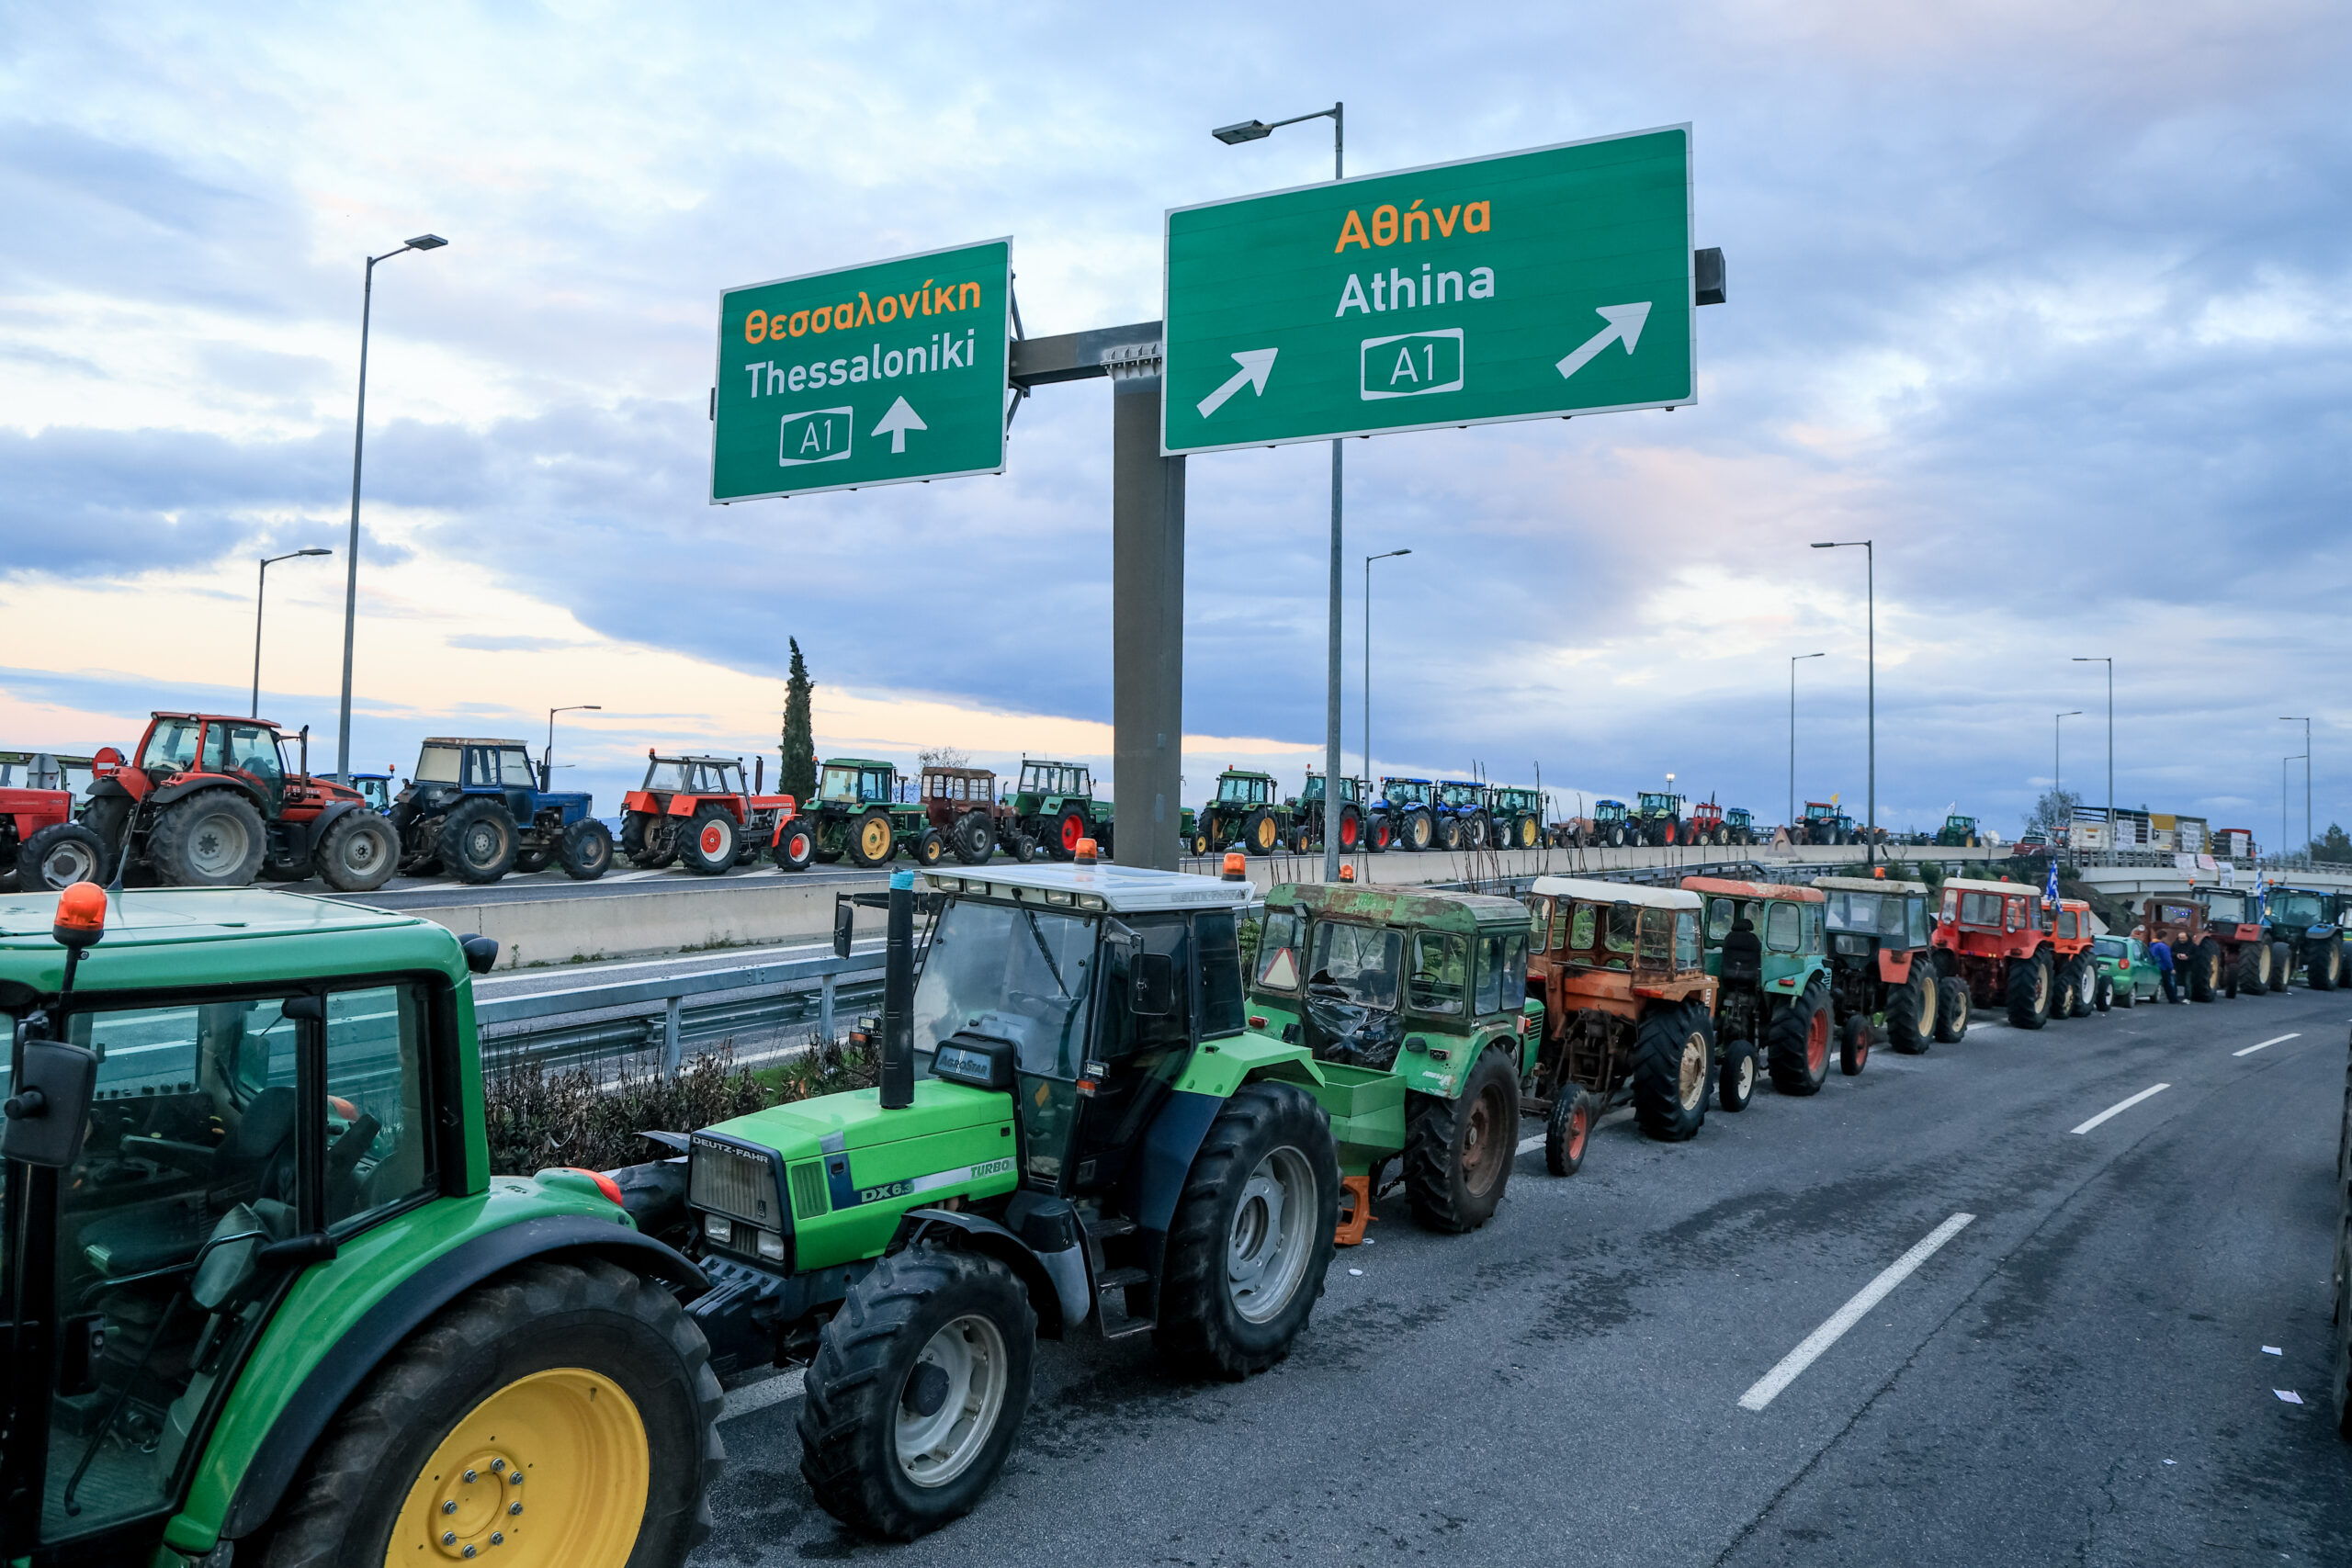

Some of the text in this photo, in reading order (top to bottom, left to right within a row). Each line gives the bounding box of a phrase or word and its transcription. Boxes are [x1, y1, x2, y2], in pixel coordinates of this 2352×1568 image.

[1334, 198, 1490, 254] Αθήνα
[745, 278, 980, 344] Θεσσαλονίκη
[1335, 263, 1495, 318] Athina
[744, 329, 975, 399] Thessaloniki
[1389, 344, 1435, 386] A1
[799, 419, 831, 454] A1
[970, 1159, 1010, 1179] TURBO
[861, 1185, 891, 1203] DX
